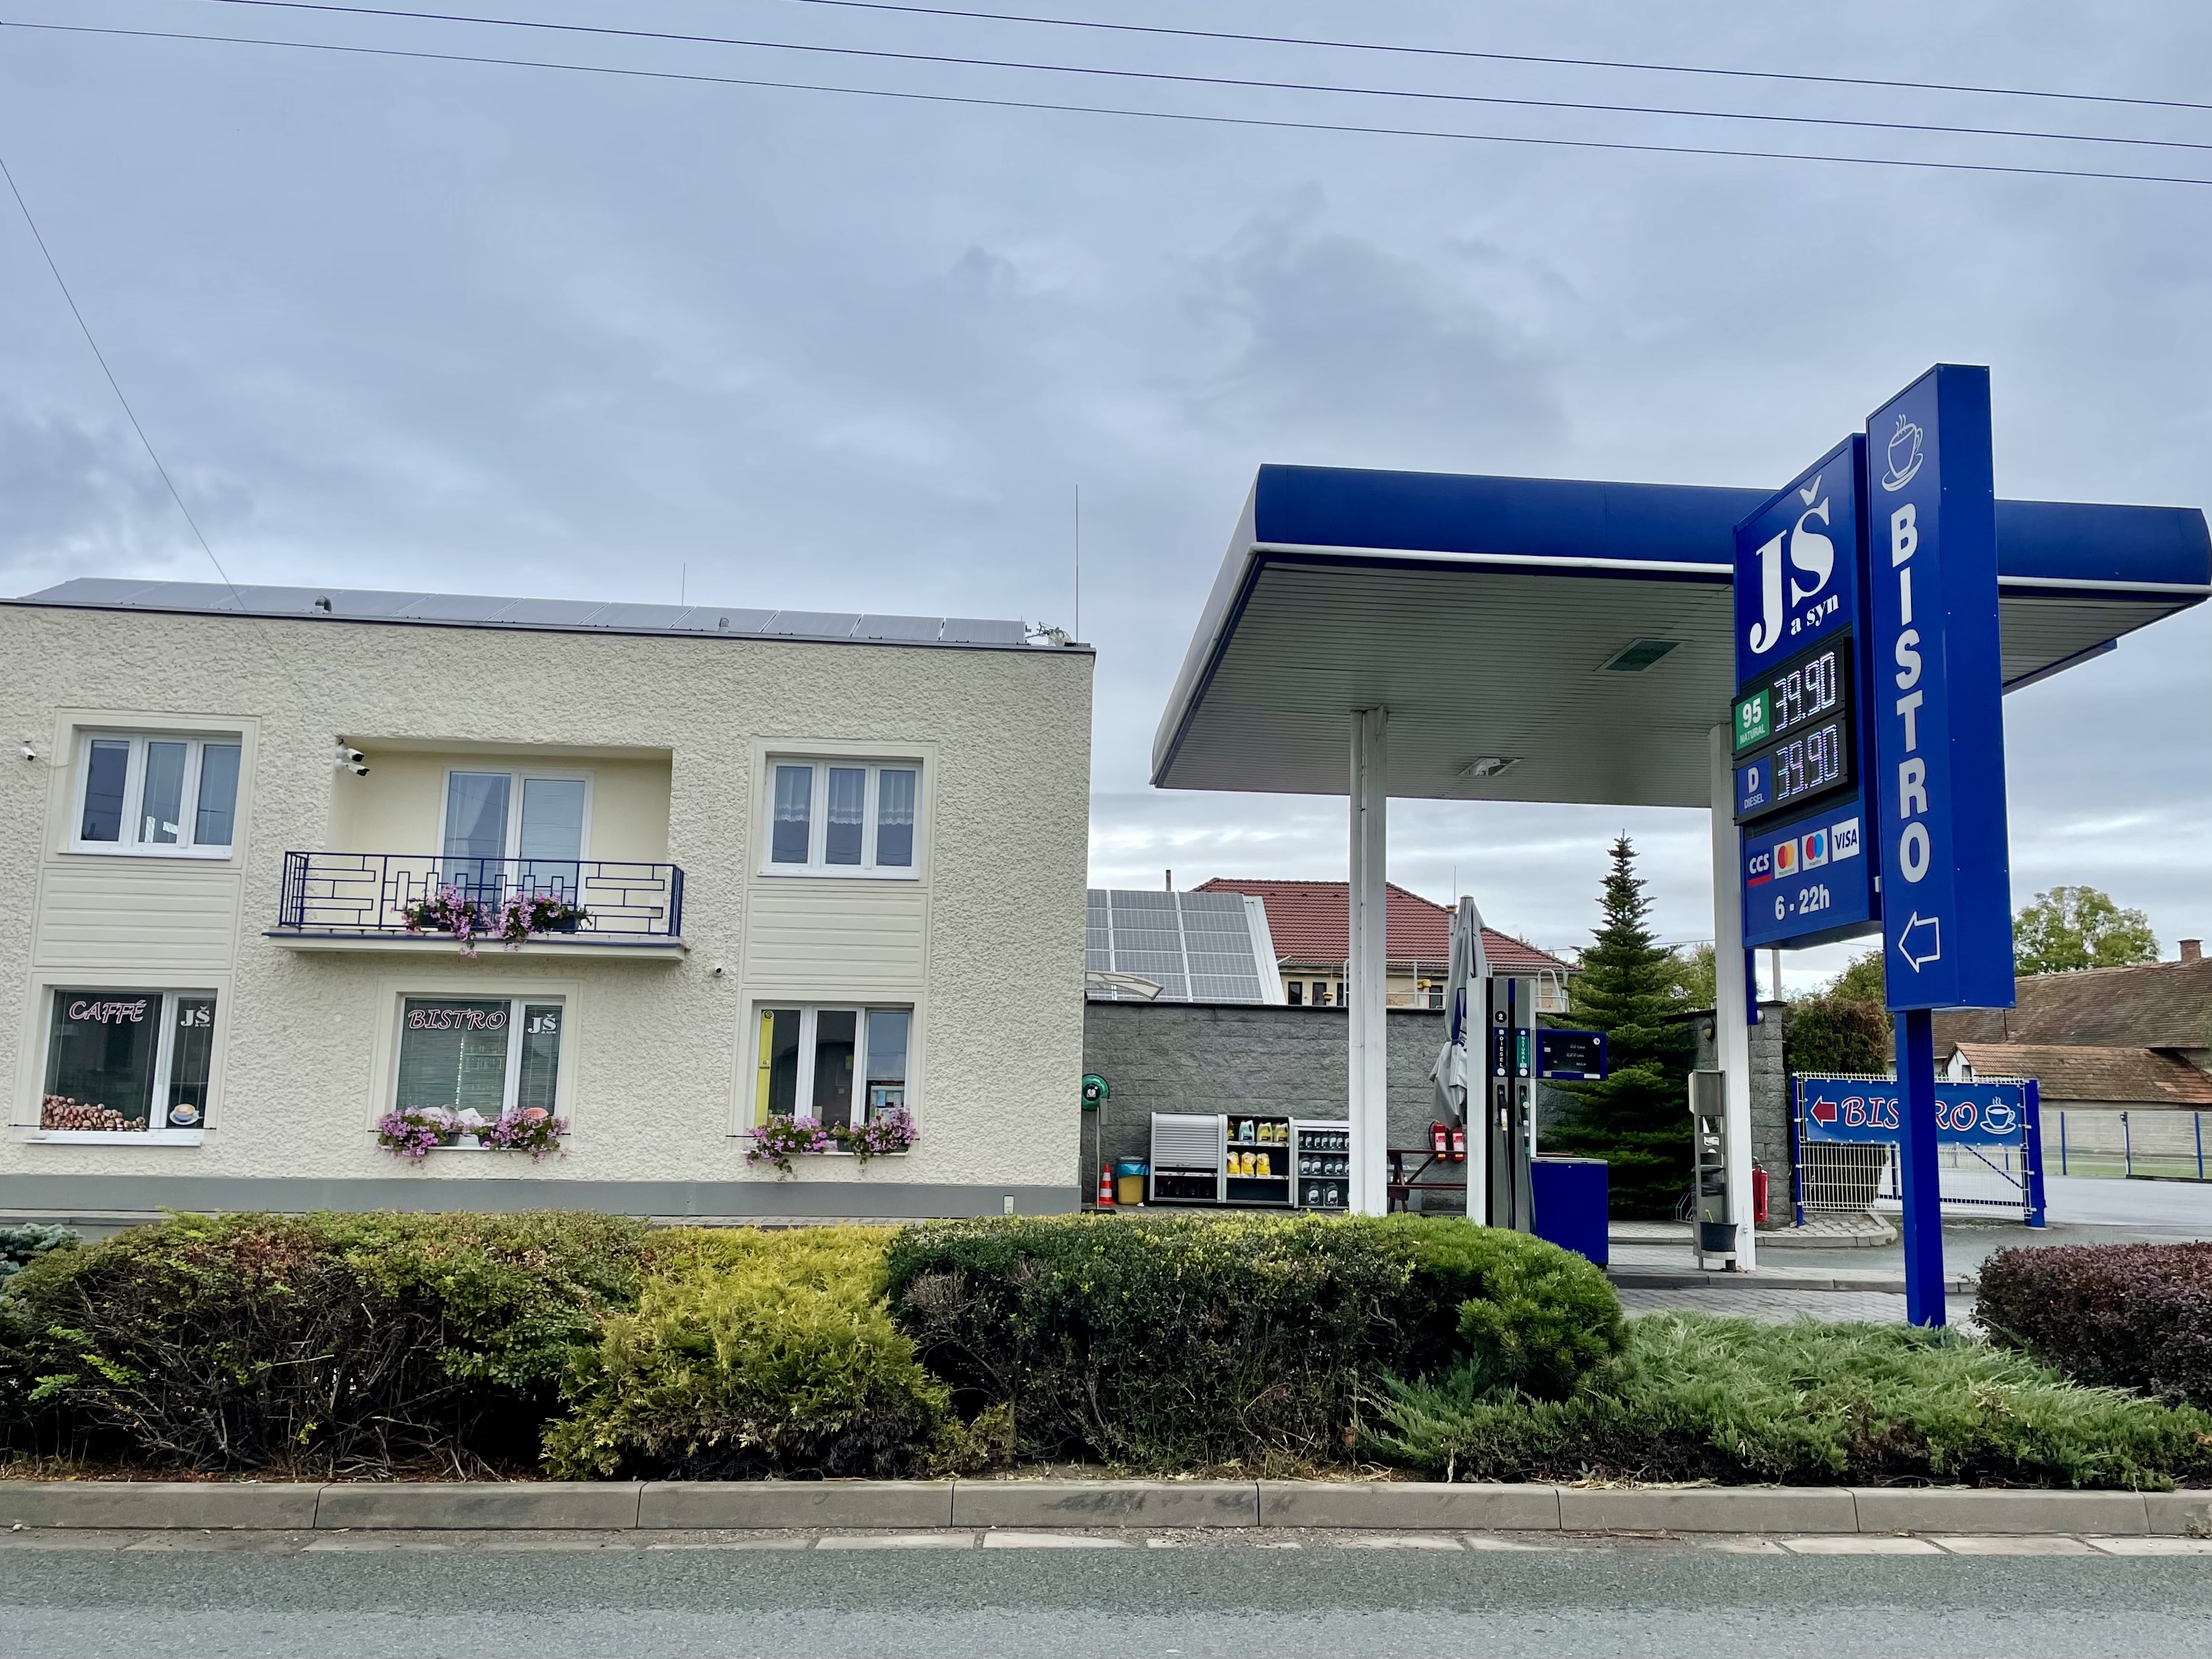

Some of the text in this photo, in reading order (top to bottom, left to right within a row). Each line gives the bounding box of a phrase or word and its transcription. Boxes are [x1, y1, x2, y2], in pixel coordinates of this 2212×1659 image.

[1749, 474, 1834, 654] JŠ
[1791, 594, 1839, 636] a syn
[1891, 502, 1931, 884] BISTRO
[1742, 697, 1762, 728] 95
[1740, 724, 1765, 745] NATURAL
[1747, 766, 1759, 794] D
[1744, 793, 1765, 809] DIESEL
[1834, 829, 1858, 850] VISA
[1749, 853, 1770, 874] CCS
[1775, 895, 1785, 920] 6
[1799, 883, 1830, 915] 22h
[69, 999, 147, 1024] CAFFÉ
[180, 1005, 210, 1026] JŠ
[408, 1008, 507, 1031] BISTRO
[528, 1013, 556, 1034] JŠ
[1842, 1097, 1978, 1132] BISRO
